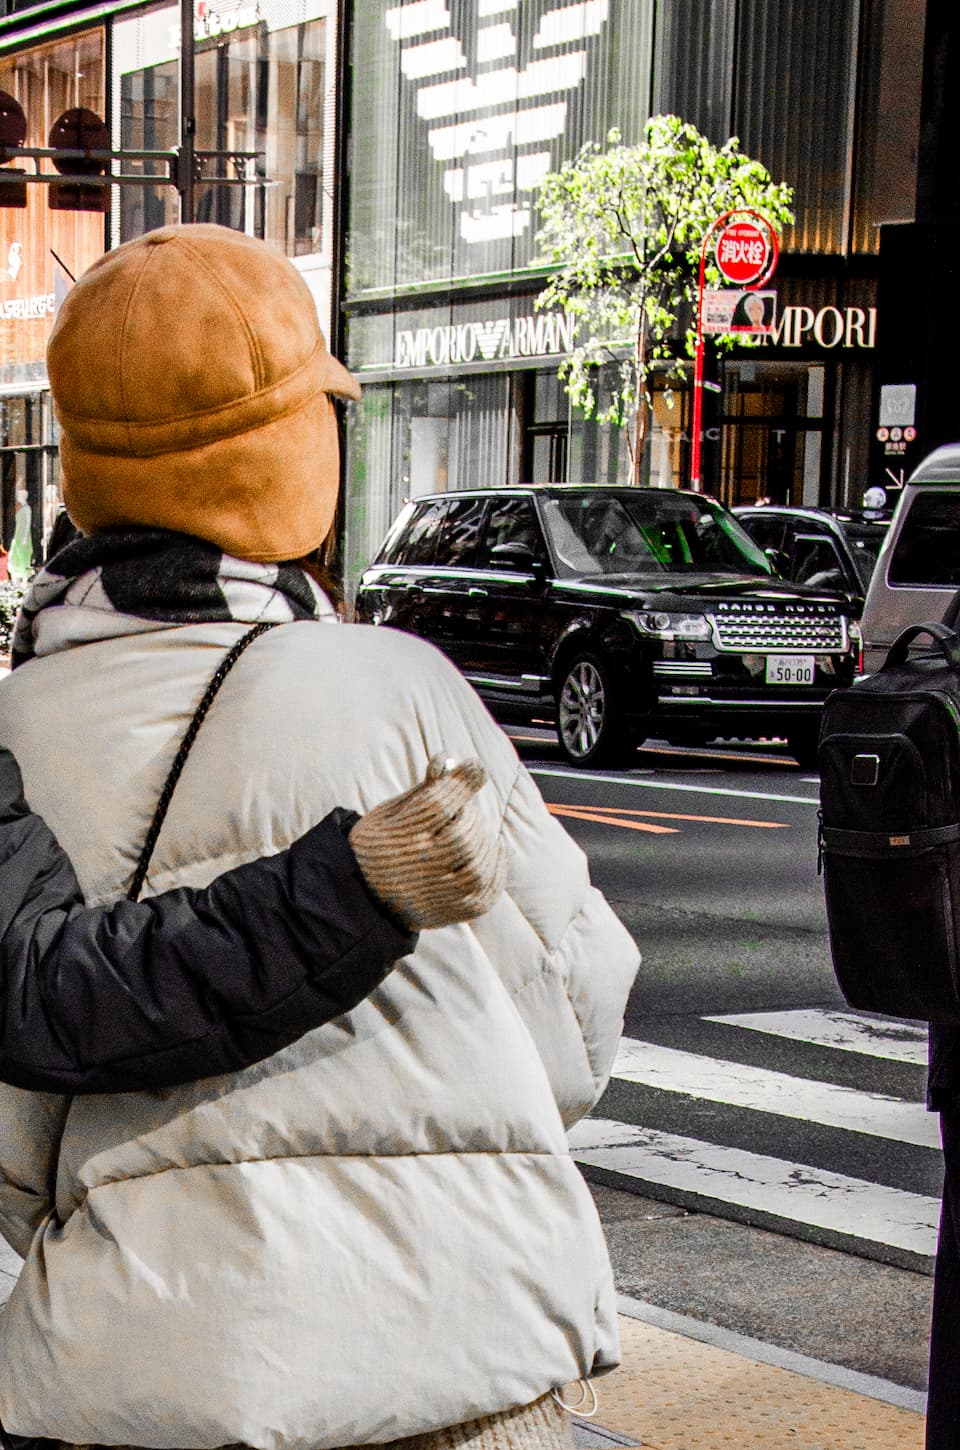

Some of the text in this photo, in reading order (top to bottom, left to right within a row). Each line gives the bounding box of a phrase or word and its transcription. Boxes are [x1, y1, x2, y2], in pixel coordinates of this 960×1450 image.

[720, 239, 764, 265] 消火栓
[740, 306, 878, 348] MPORI
[395, 322, 477, 368] EMPORIO
[718, 602, 776, 611] RANGE
[777, 667, 811, 682] 50-00
